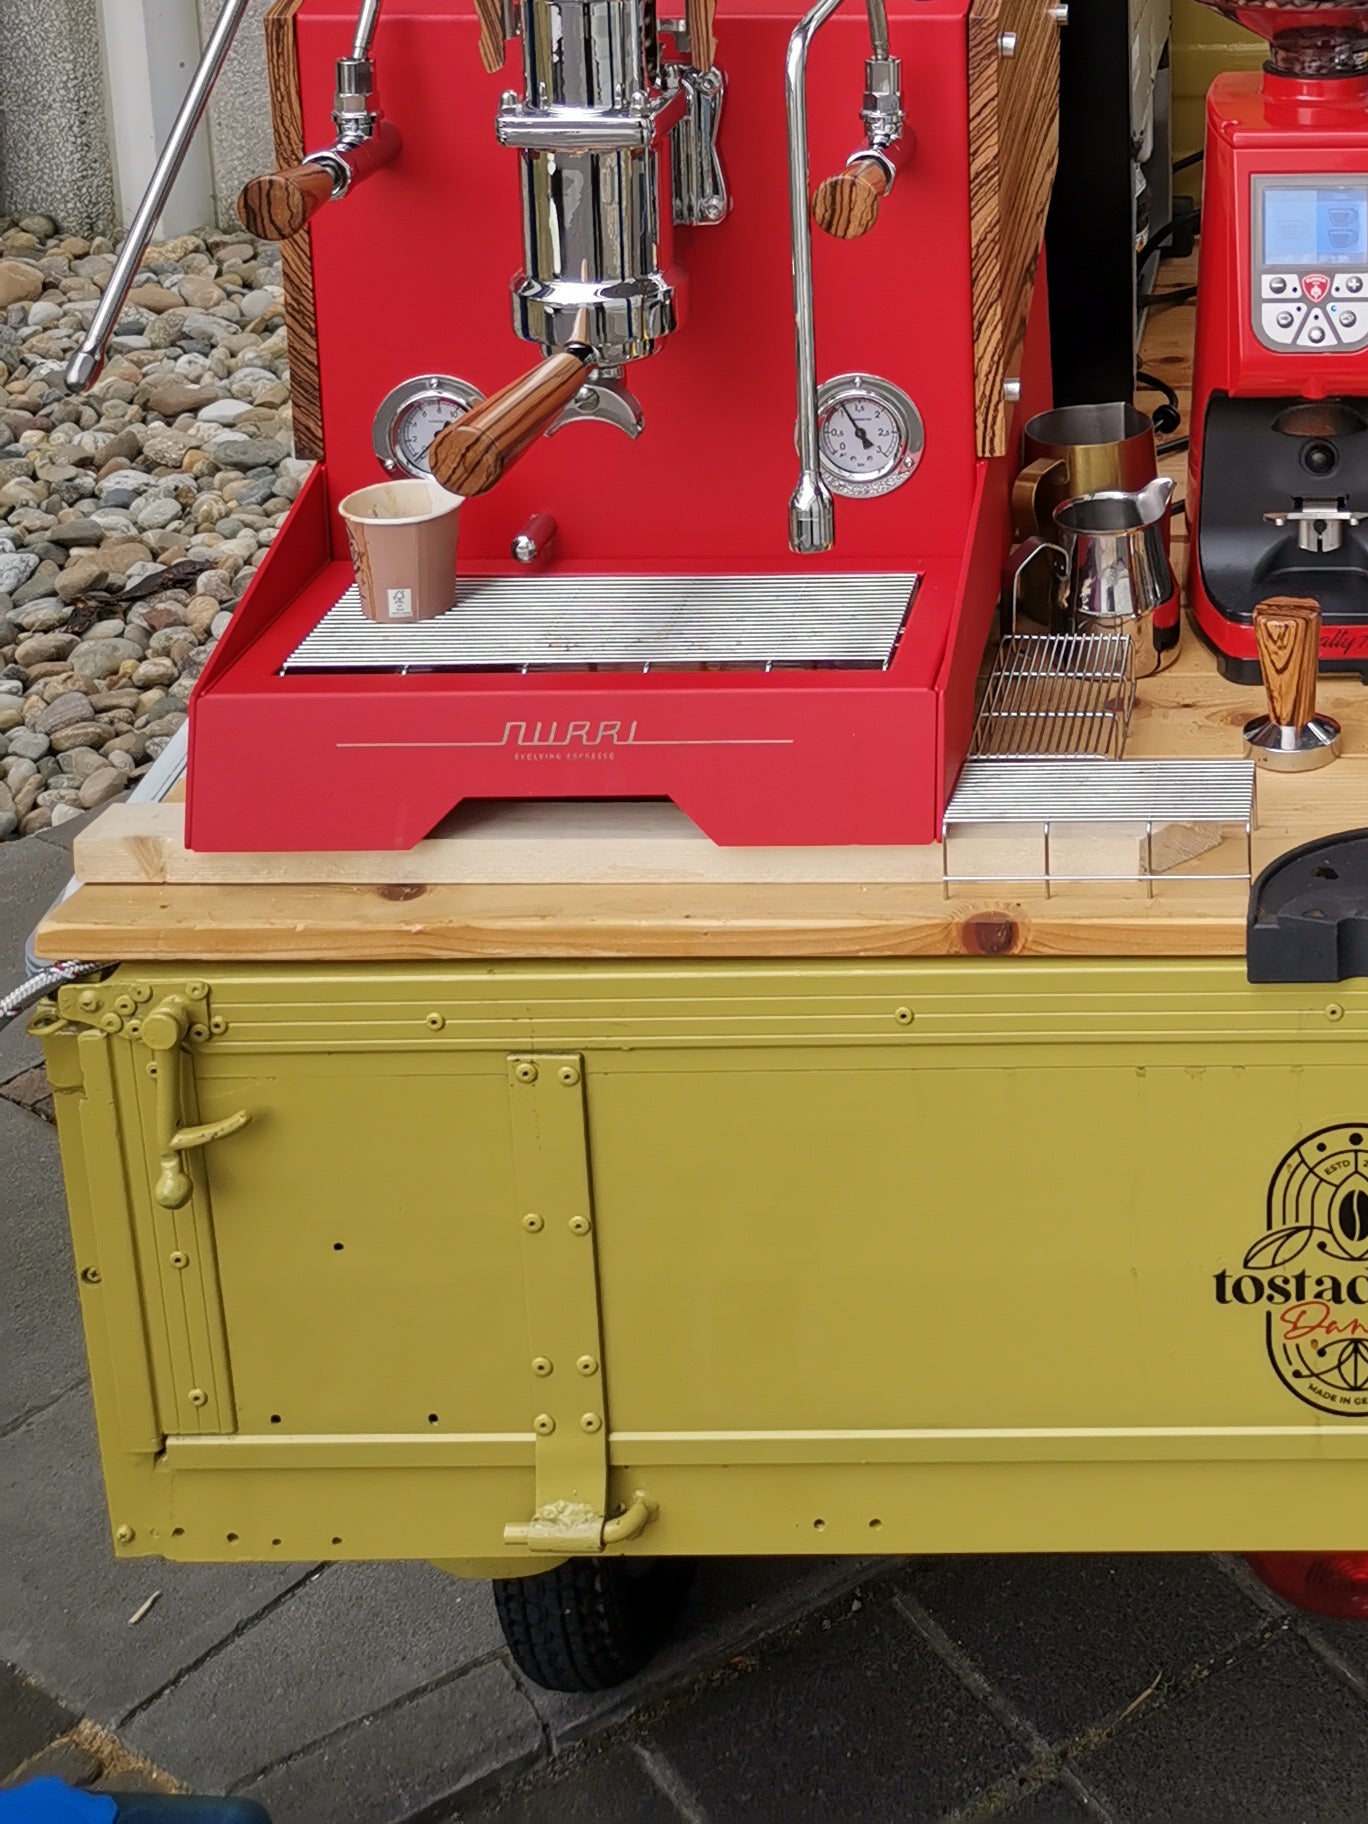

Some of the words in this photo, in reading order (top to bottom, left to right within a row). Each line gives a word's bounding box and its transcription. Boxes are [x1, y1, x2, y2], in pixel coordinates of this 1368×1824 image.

[874, 410, 881, 419] 2
[1323, 1159, 1351, 1176] ESTD
[1307, 1382, 1337, 1404] MADE
[1339, 1396, 1351, 1405] IN
